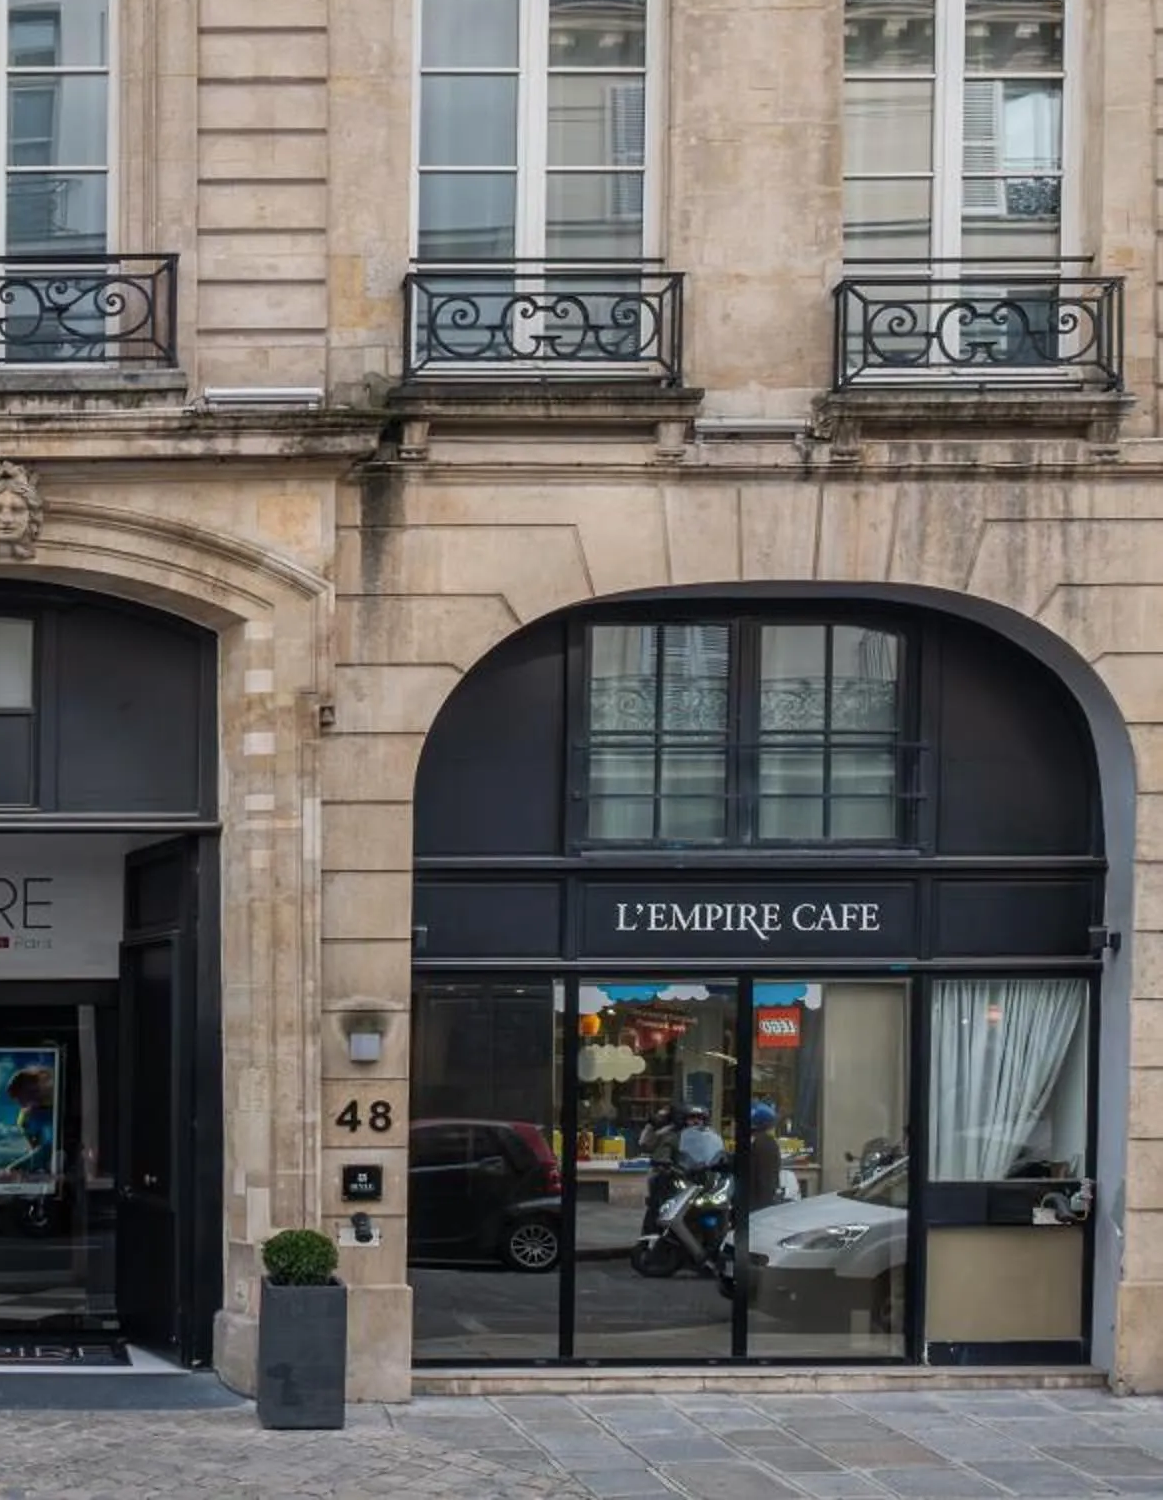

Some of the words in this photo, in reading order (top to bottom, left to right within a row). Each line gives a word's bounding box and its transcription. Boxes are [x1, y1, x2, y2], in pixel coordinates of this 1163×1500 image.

[616, 903, 782, 941] L'EMPIRE
[792, 903, 880, 932] CAFE
[335, 1100, 392, 1133] 48
